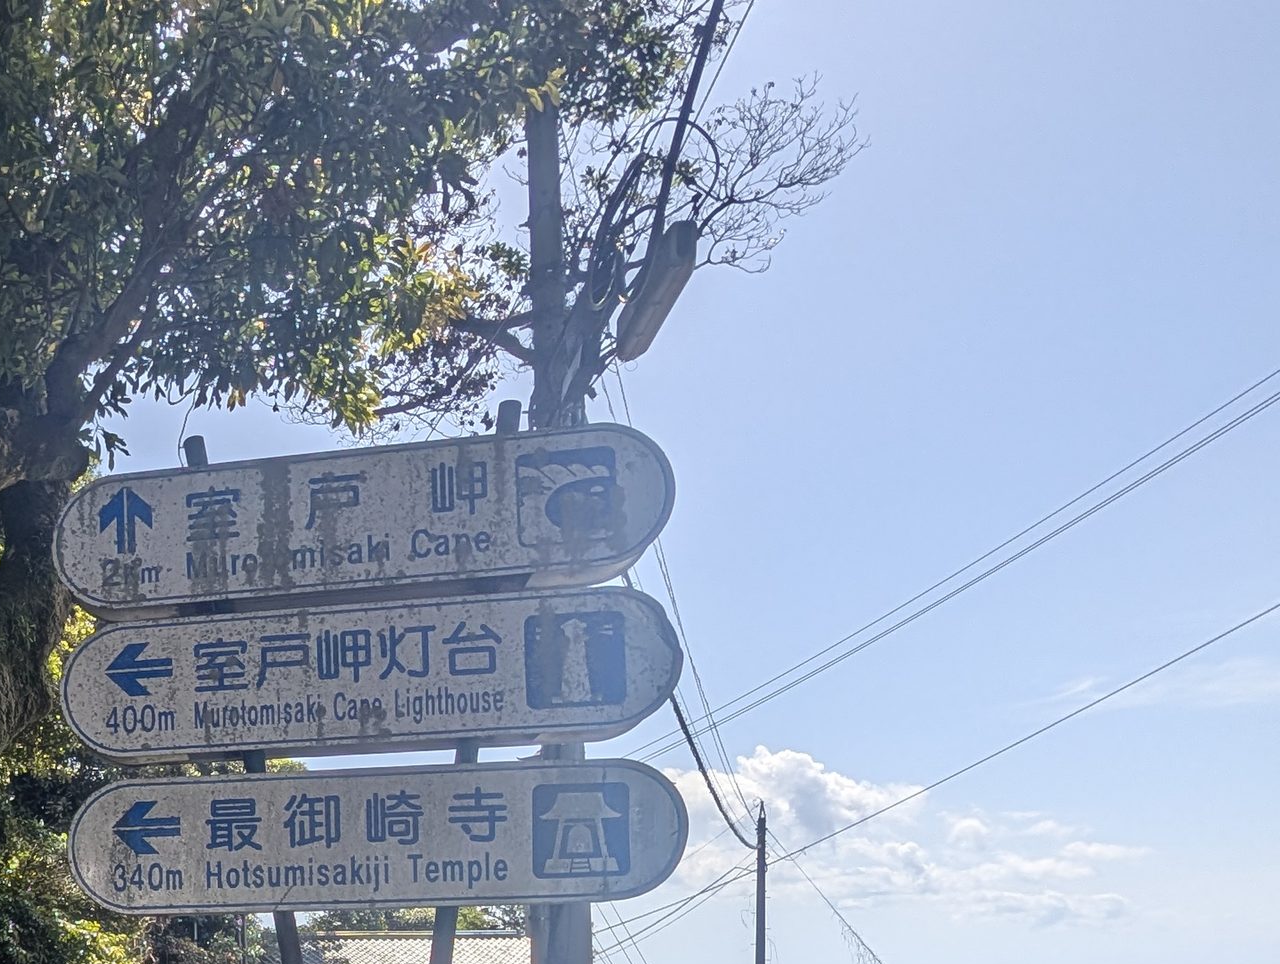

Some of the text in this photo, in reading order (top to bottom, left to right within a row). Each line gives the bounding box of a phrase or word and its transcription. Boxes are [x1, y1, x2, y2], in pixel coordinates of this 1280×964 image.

[186, 462, 488, 542] 室戸岬
[193, 621, 503, 692] 室戸岬灯台
[105, 703, 176, 734] 400m
[394, 686, 504, 724] Lighthouse
[205, 786, 508, 851] 最御崎寺
[113, 852, 509, 892] 340m Hotsumisakiji Temple
